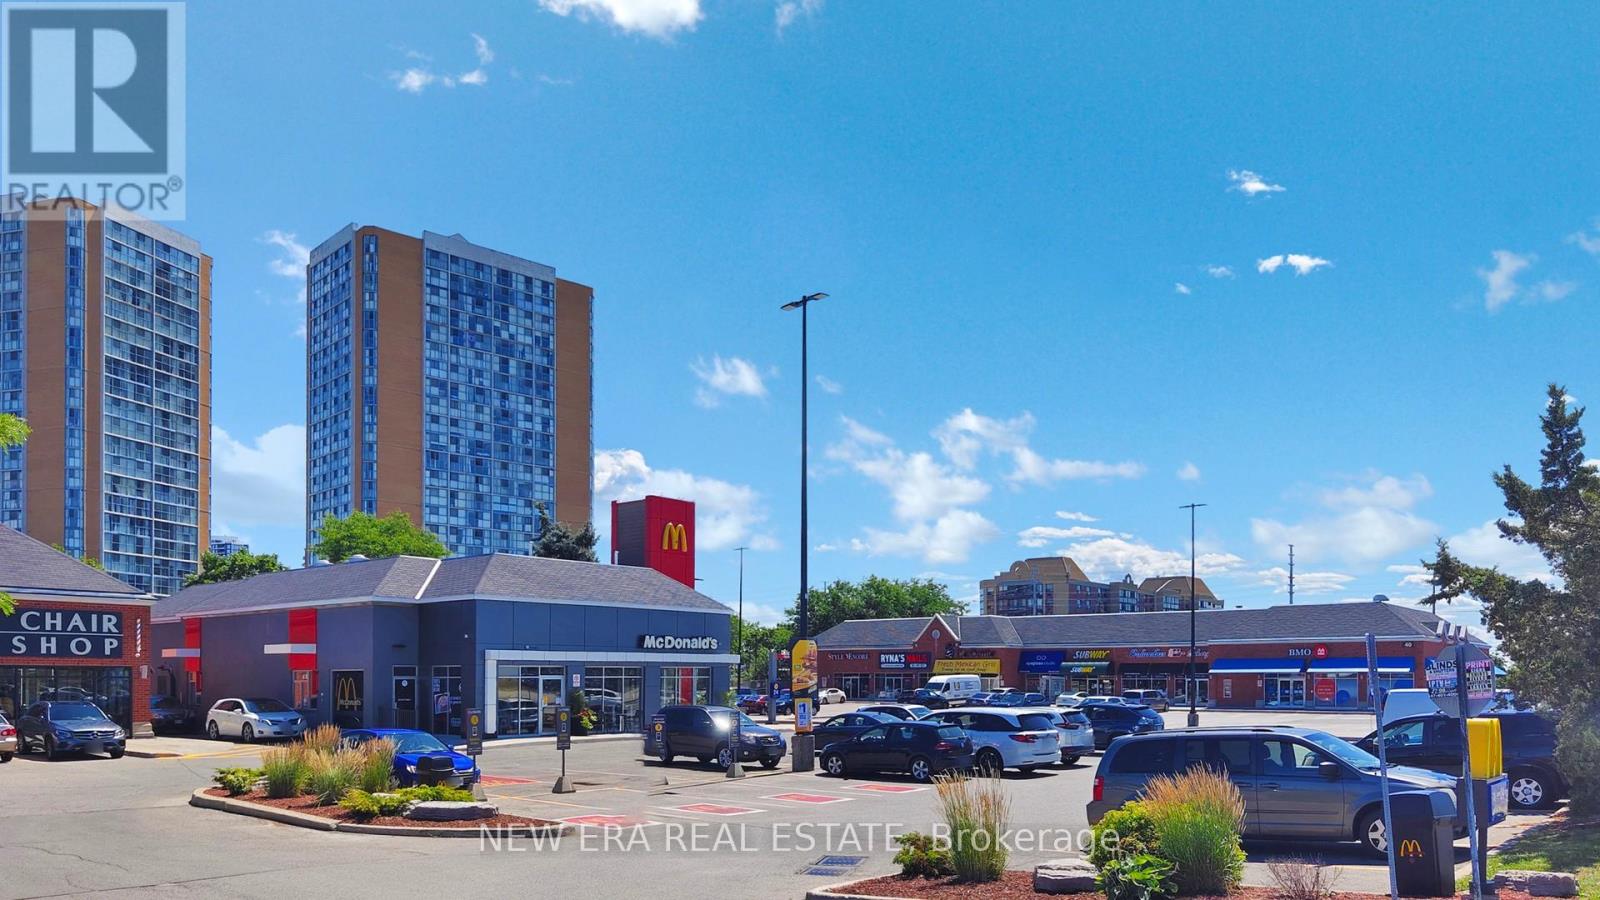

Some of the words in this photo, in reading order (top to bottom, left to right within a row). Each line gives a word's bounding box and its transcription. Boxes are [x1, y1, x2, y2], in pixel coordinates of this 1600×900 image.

[20, 611, 119, 633] CHAIR
[11, 635, 118, 655] SHOP
[643, 635, 718, 650] McDonald's
[1073, 650, 1110, 660] SUBWAY
[1288, 648, 1311, 656] BMO
[880, 654, 905, 663] RYNA'S
[1465, 660, 1490, 669] PRINT
